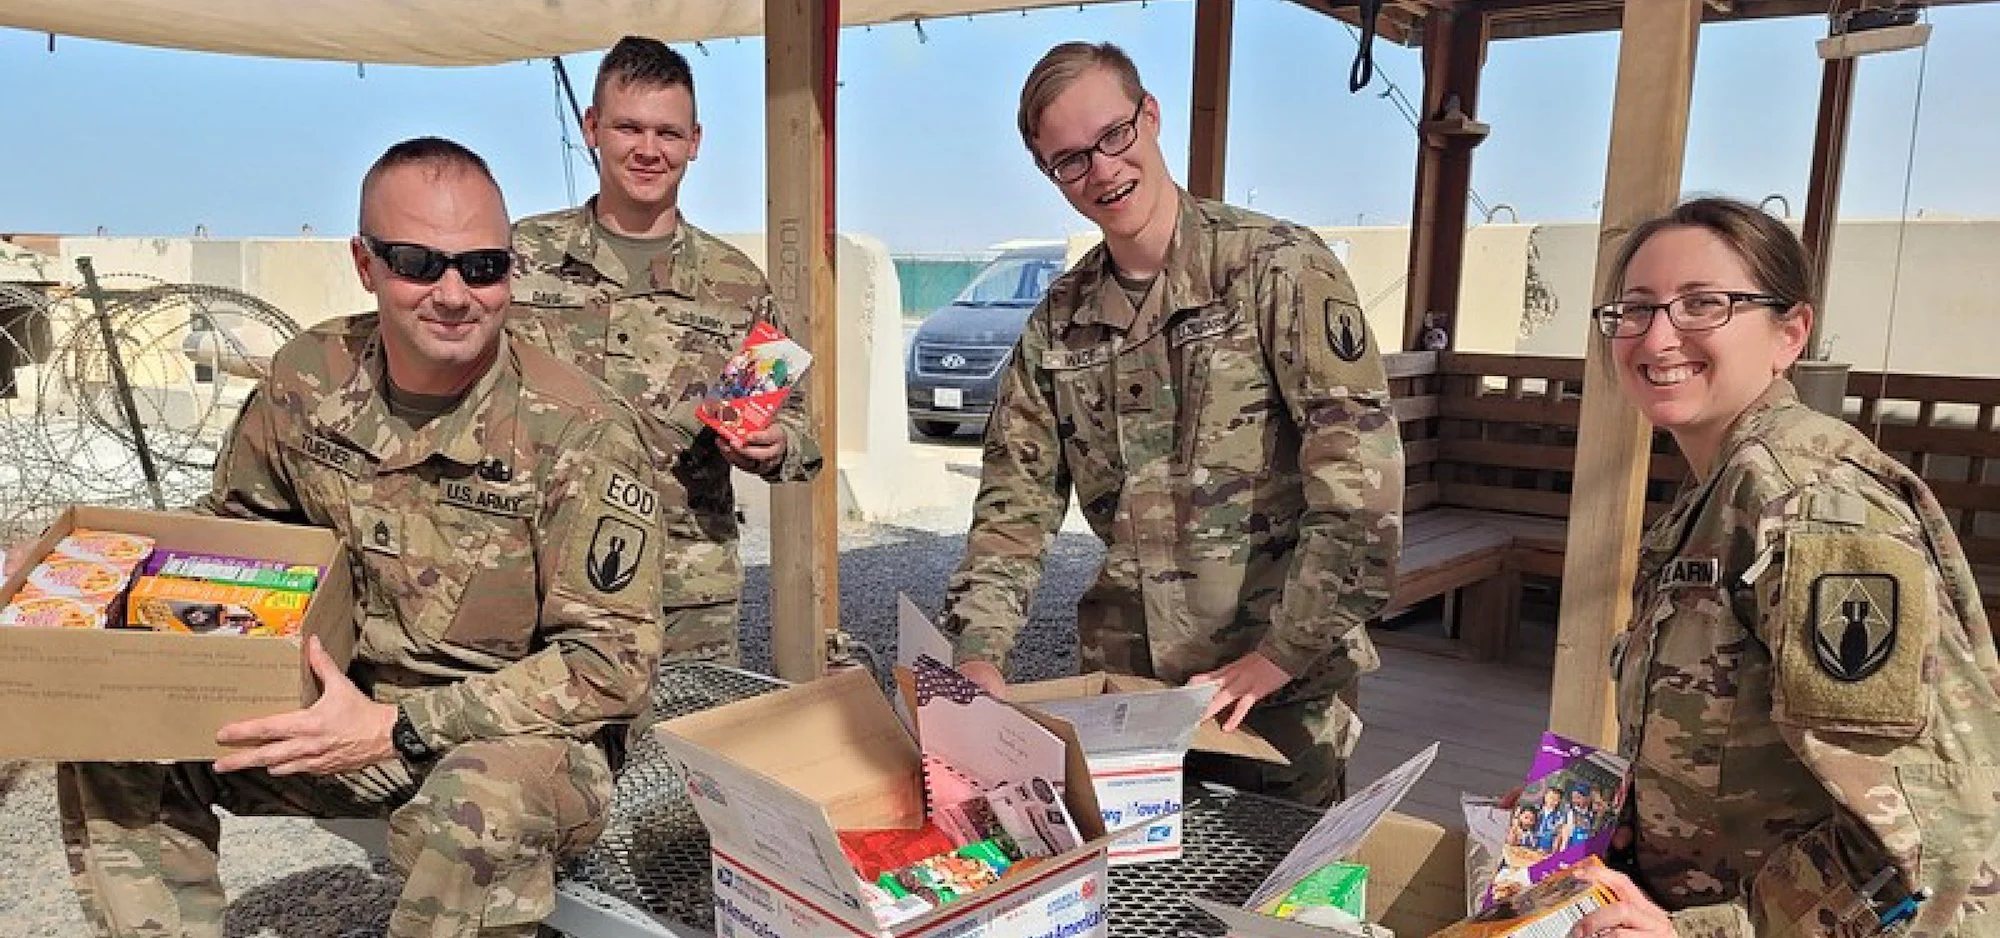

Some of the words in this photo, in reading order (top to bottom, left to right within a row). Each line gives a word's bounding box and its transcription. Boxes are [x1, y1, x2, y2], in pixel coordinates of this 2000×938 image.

[302, 433, 350, 466] TURNER
[446, 483, 472, 503] U.S.
[476, 493, 522, 512] ARMY
[607, 473, 653, 515] EOD
[1672, 560, 1713, 582] ARM
